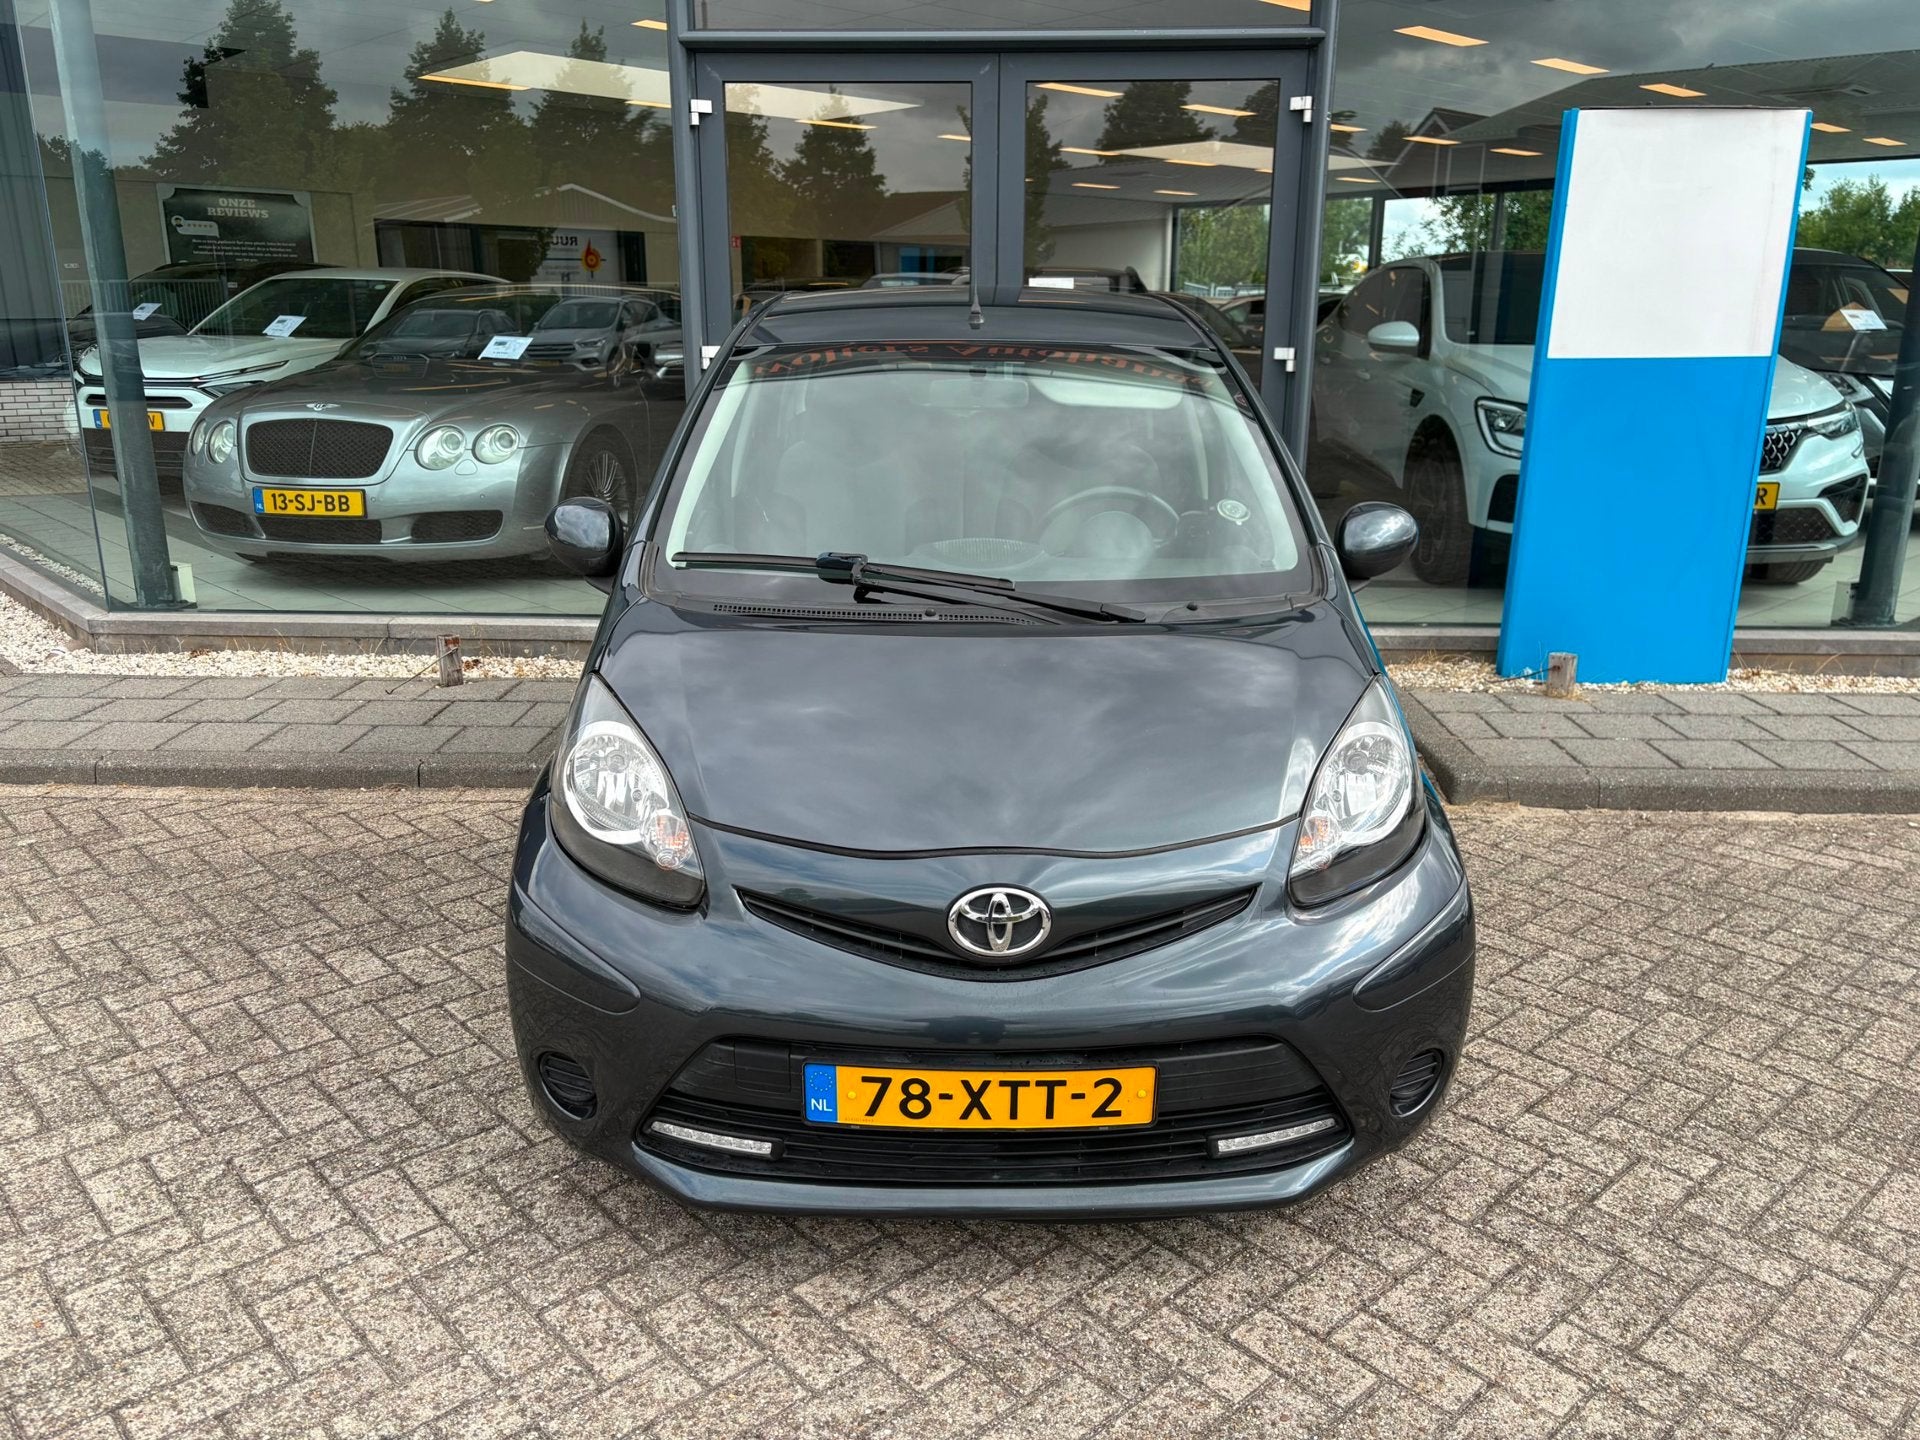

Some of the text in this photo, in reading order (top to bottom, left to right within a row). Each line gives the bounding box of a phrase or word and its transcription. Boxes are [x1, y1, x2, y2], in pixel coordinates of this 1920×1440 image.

[218, 197, 256, 208] ONZE
[207, 206, 270, 219] REVIEWS
[271, 492, 351, 513] 13-SJ-BB
[810, 1075, 1123, 1121] NL 78-XTT-2
